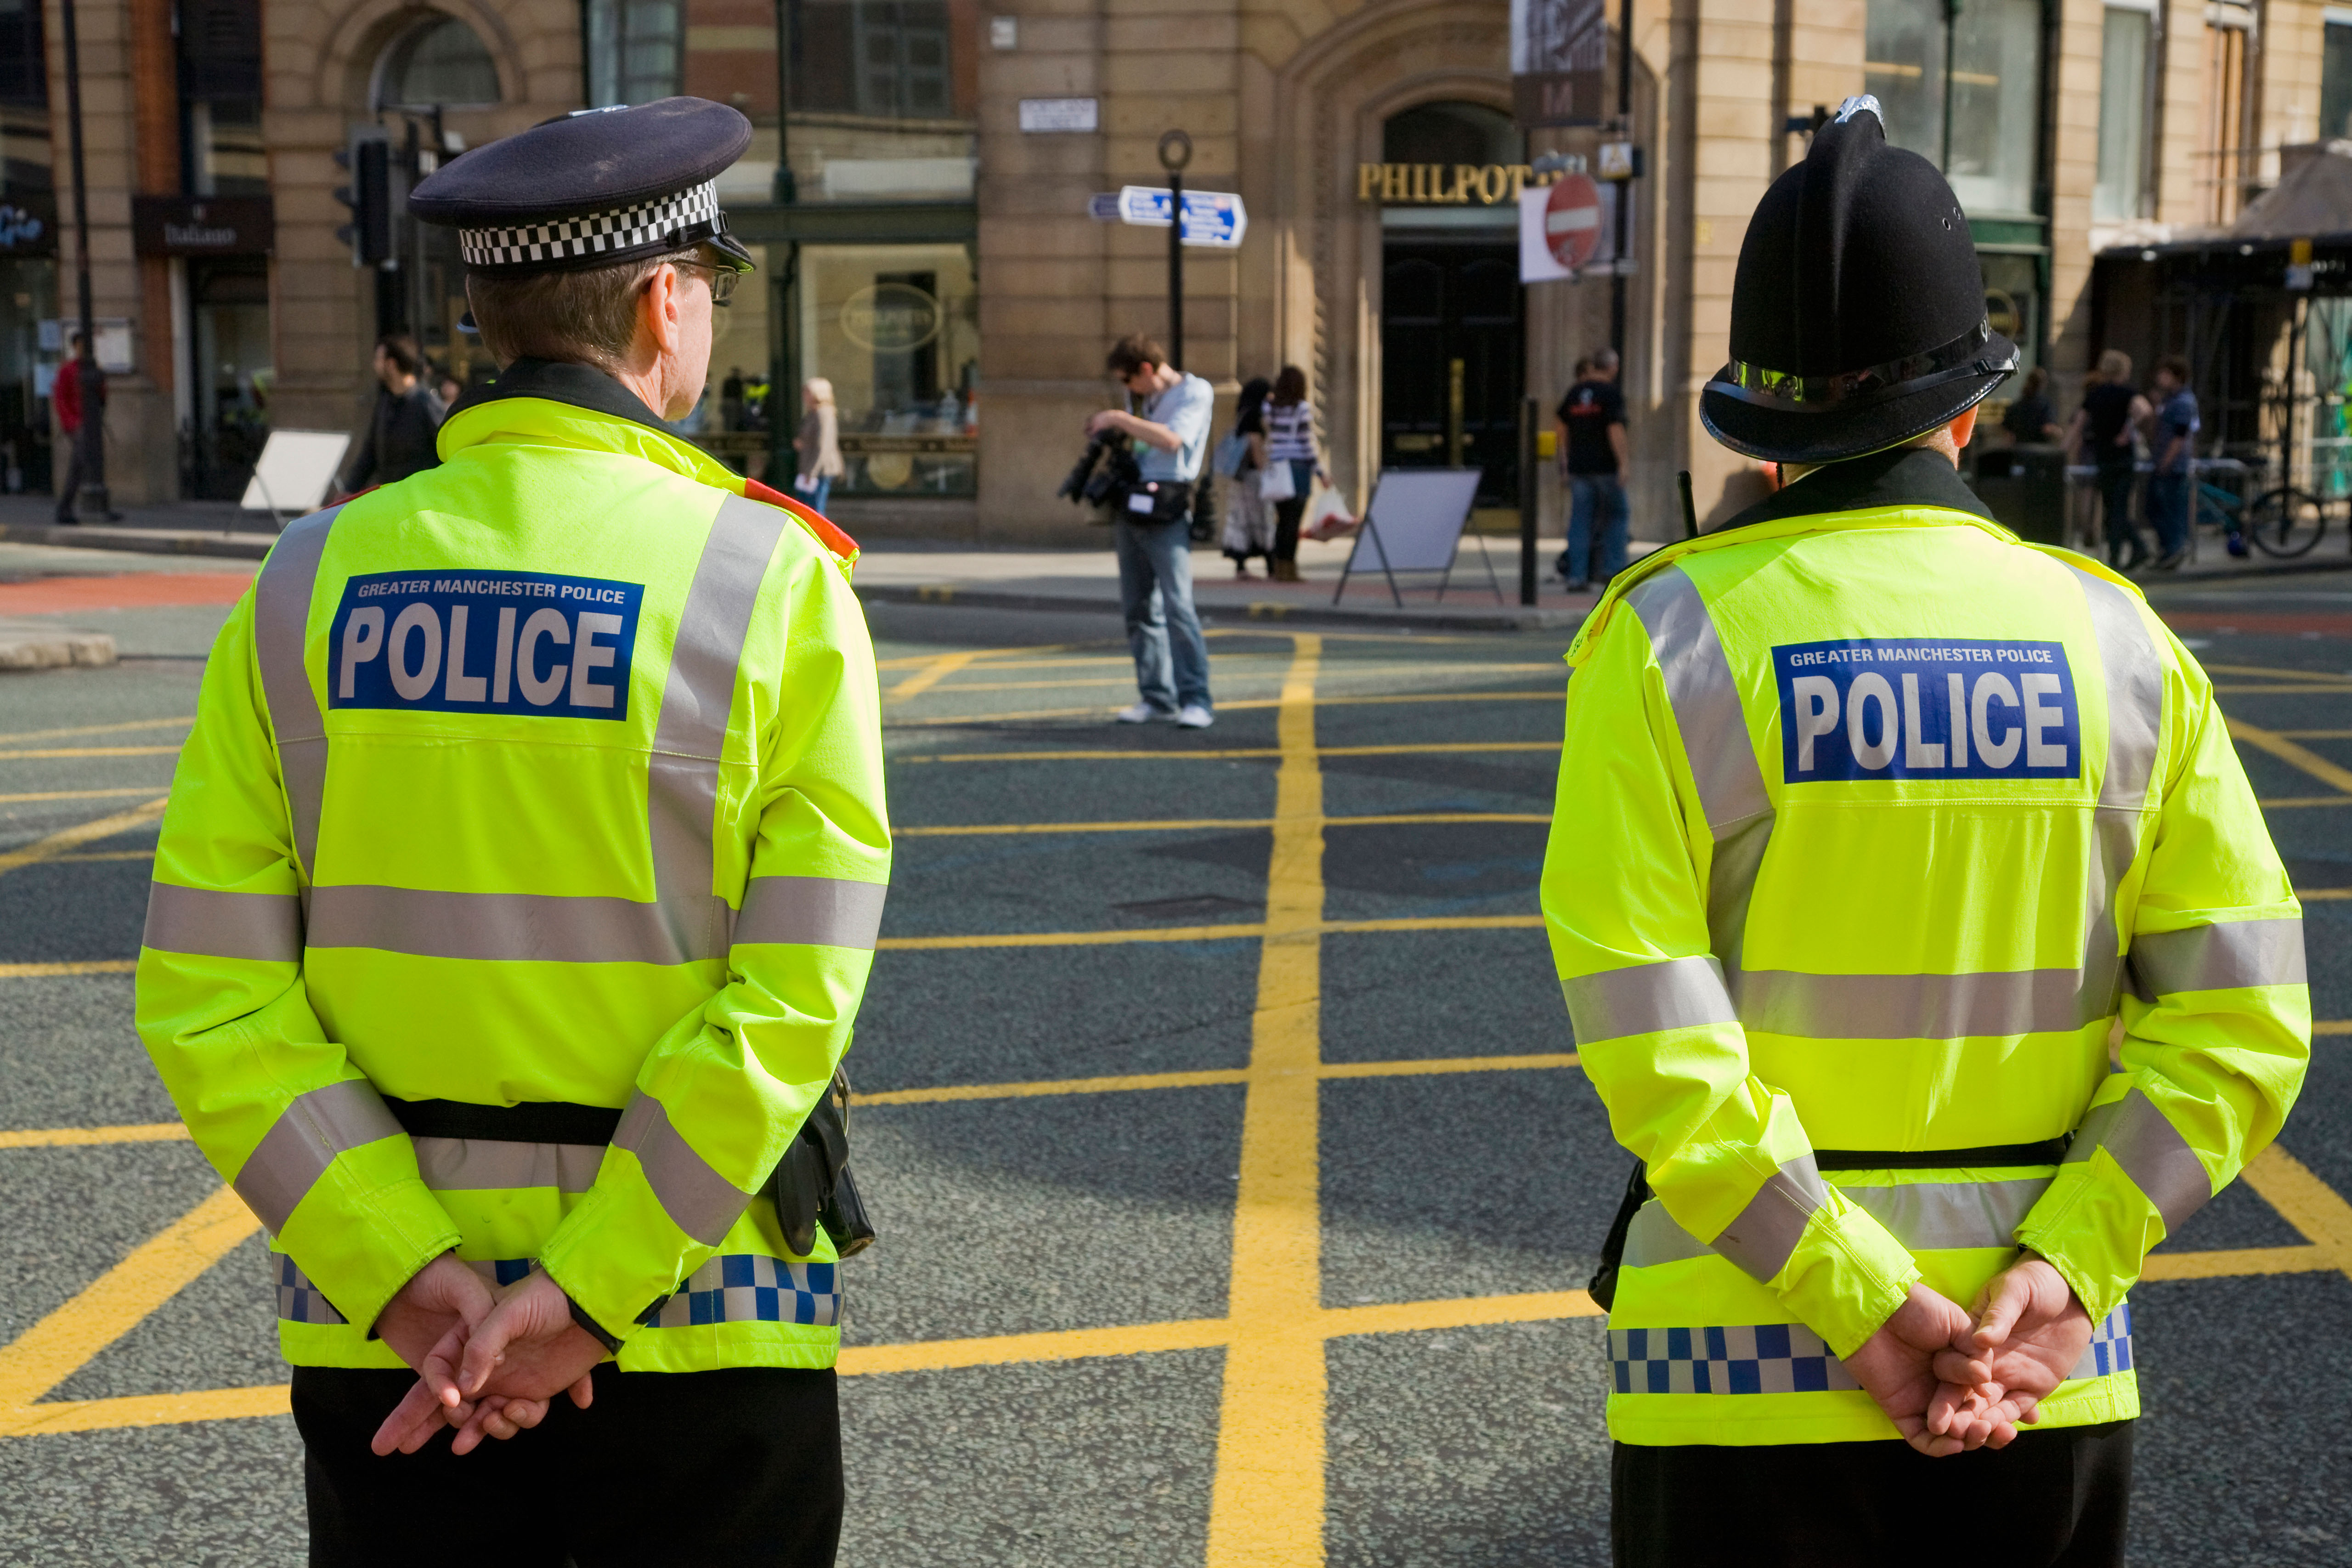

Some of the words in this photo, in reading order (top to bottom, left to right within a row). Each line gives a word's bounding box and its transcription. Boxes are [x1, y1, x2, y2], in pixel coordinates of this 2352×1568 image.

[358, 580, 430, 597] GREATER
[433, 579, 556, 598] MANCHESTER
[561, 585, 625, 604] POLICE
[339, 602, 623, 708] POLICE
[1790, 649, 1873, 667] GREATER
[1878, 648, 1993, 662] MANCHESTER
[1998, 649, 2053, 663] POLICE
[1792, 672, 2067, 772] POLICE
